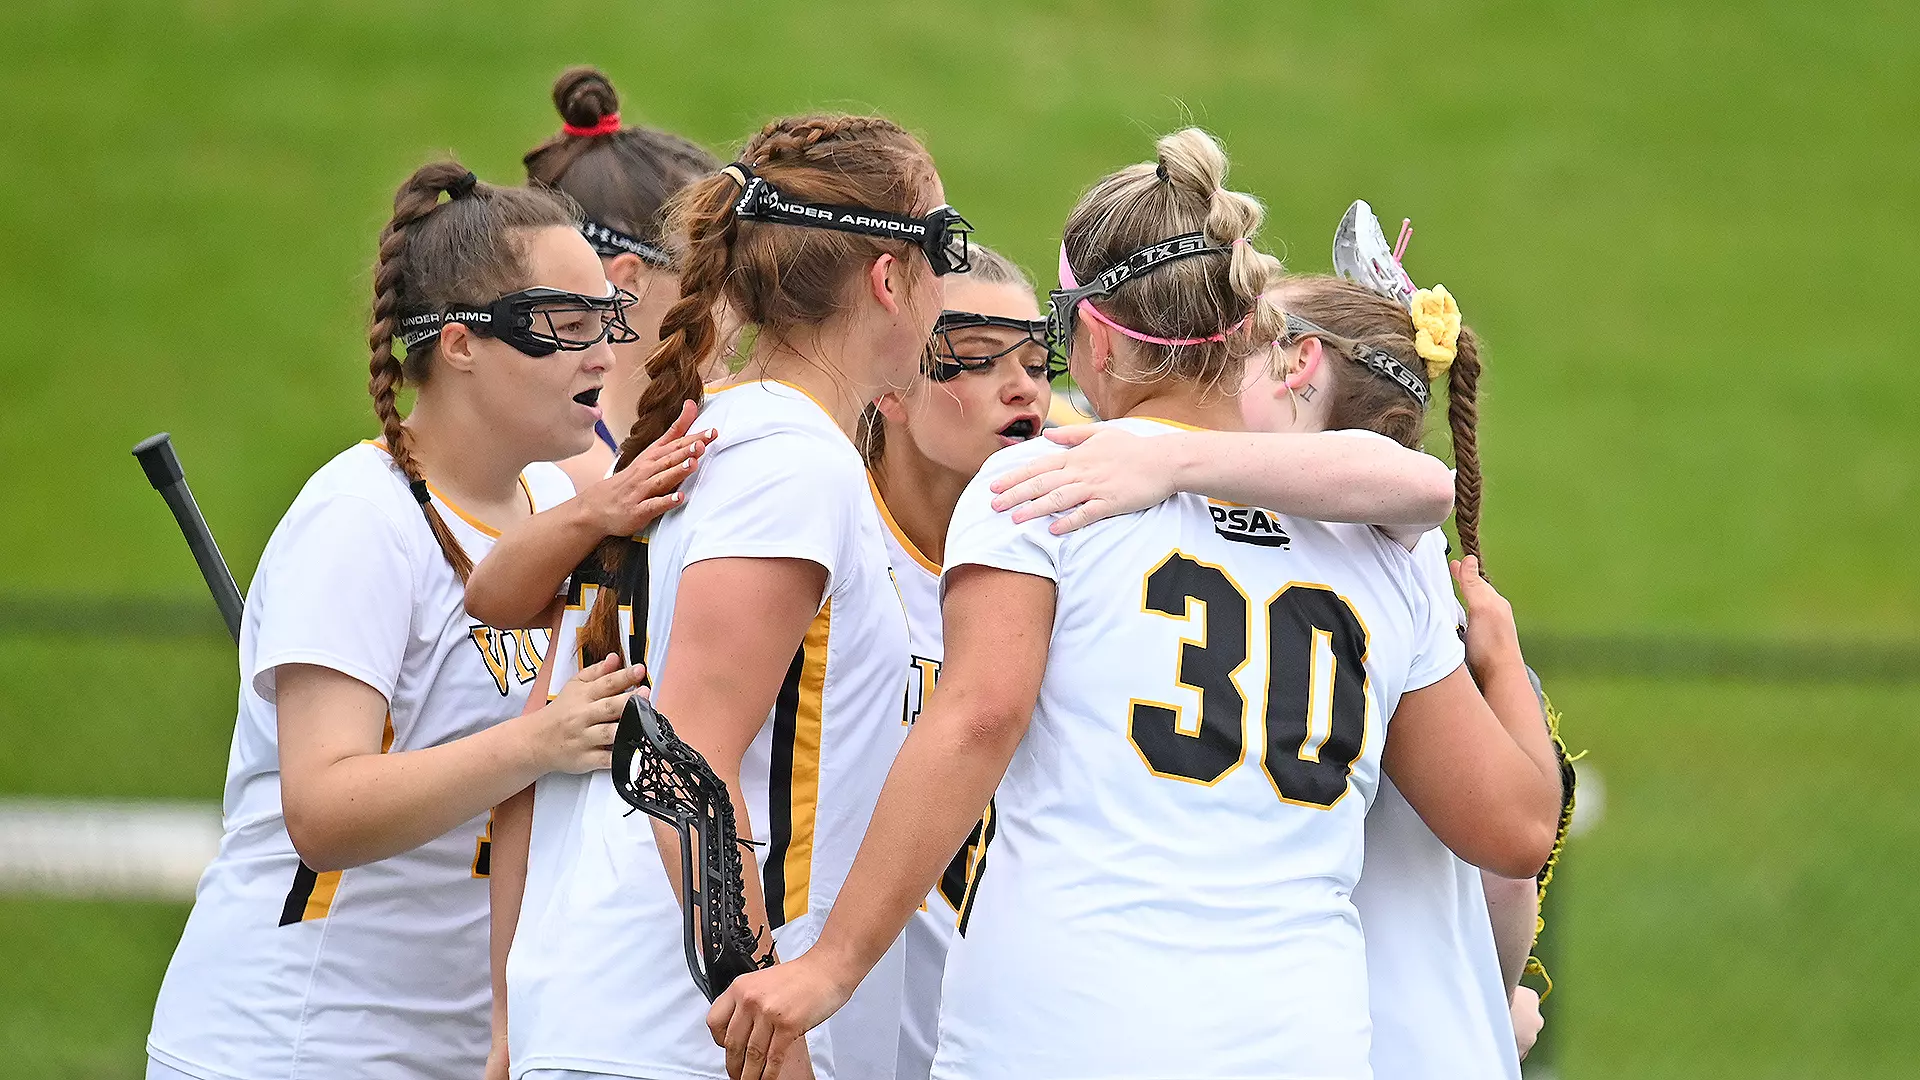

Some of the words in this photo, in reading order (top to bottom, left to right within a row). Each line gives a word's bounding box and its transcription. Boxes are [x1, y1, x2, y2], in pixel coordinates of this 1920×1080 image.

[840, 214, 926, 236] ARMOUR
[402, 313, 440, 327] UNDER
[444, 311, 492, 323] ARMO
[1126, 547, 1371, 812] 30
